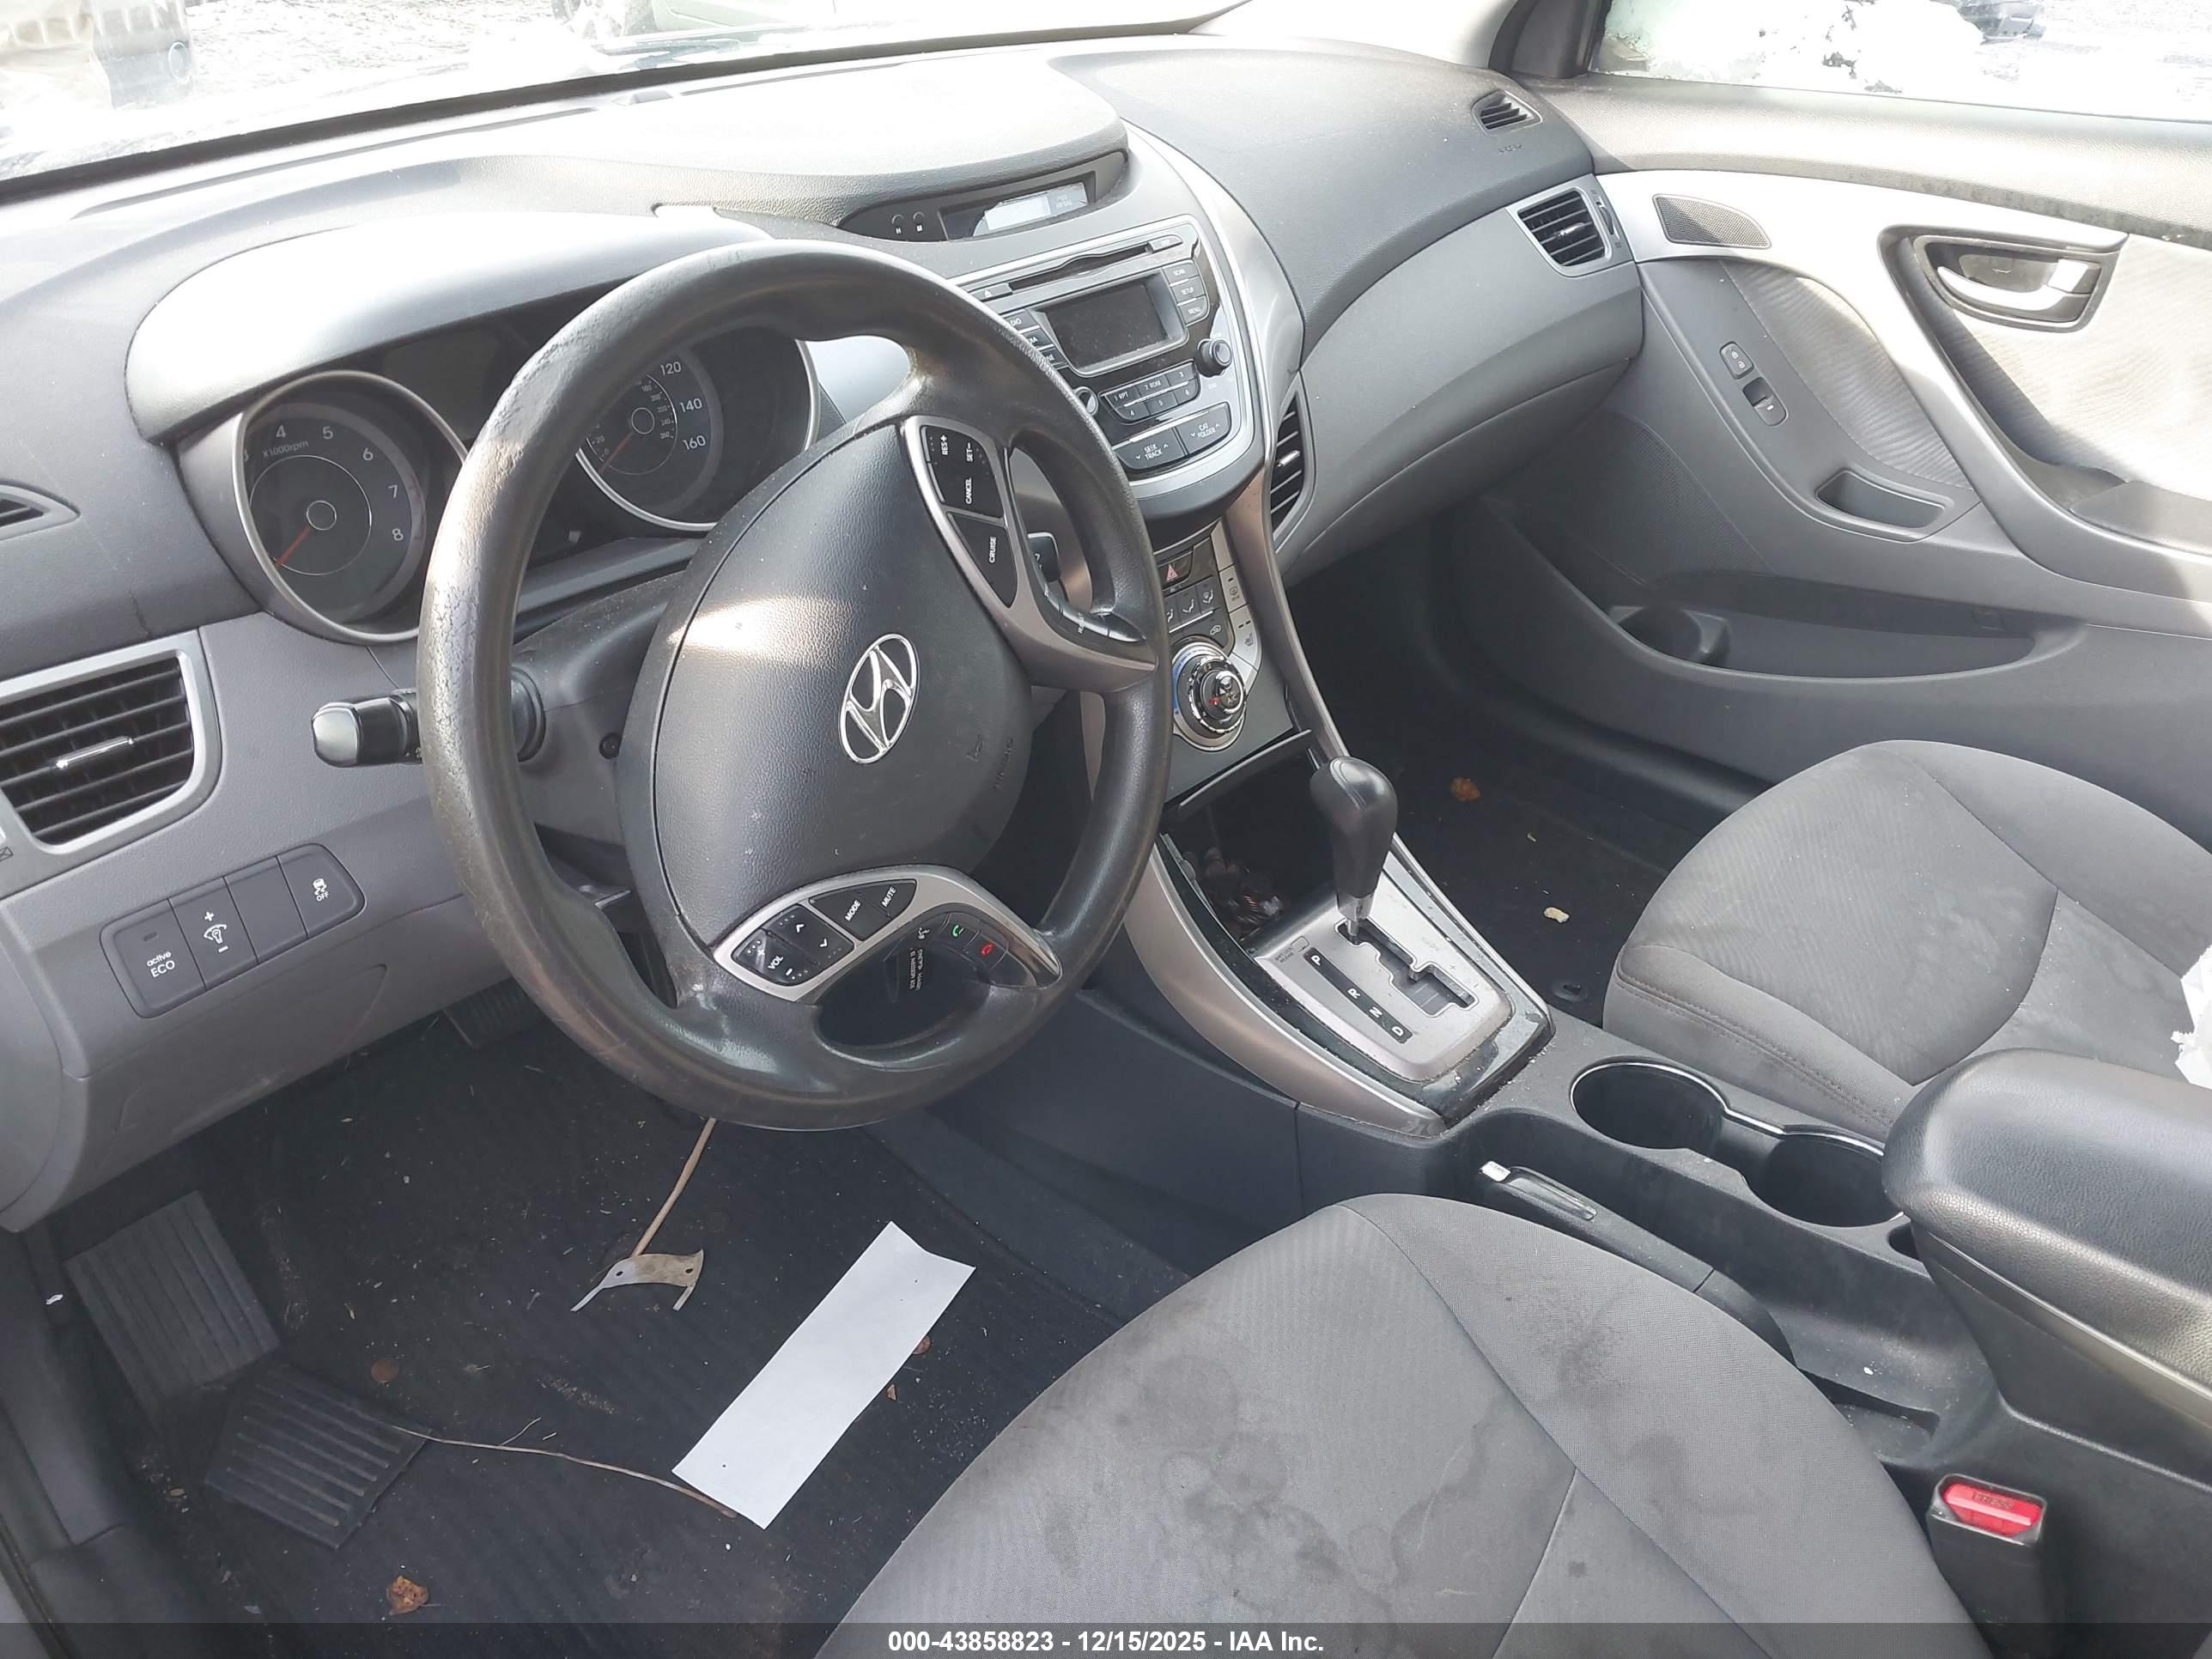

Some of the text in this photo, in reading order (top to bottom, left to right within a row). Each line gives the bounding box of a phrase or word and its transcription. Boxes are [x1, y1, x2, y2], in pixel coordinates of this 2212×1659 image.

[1181, 287, 1194, 295] SETUP
[659, 361, 682, 376] 120
[679, 398, 702, 413] 140
[276, 425, 286, 438] 4
[322, 426, 334, 440] 5
[1197, 427, 1217, 439] FOLDER
[683, 434, 706, 450] 160
[1144, 443, 1158, 453] SEEK
[362, 447, 374, 461] 6
[1144, 449, 1163, 461] TRACK
[388, 484, 398, 498] 7
[392, 528, 404, 541] 8
[988, 536, 997, 563] CRUISE
[316, 891, 330, 902] OFF
[881, 886, 896, 908] MUTE
[844, 899, 861, 921] MODE
[146, 951, 173, 967] active
[768, 955, 784, 970] VOL
[1310, 954, 1322, 967] P
[150, 959, 176, 978] ECO
[1347, 988, 1361, 1000] R
[1369, 1006, 1383, 1018] N
[1391, 1025, 1405, 1037] D
